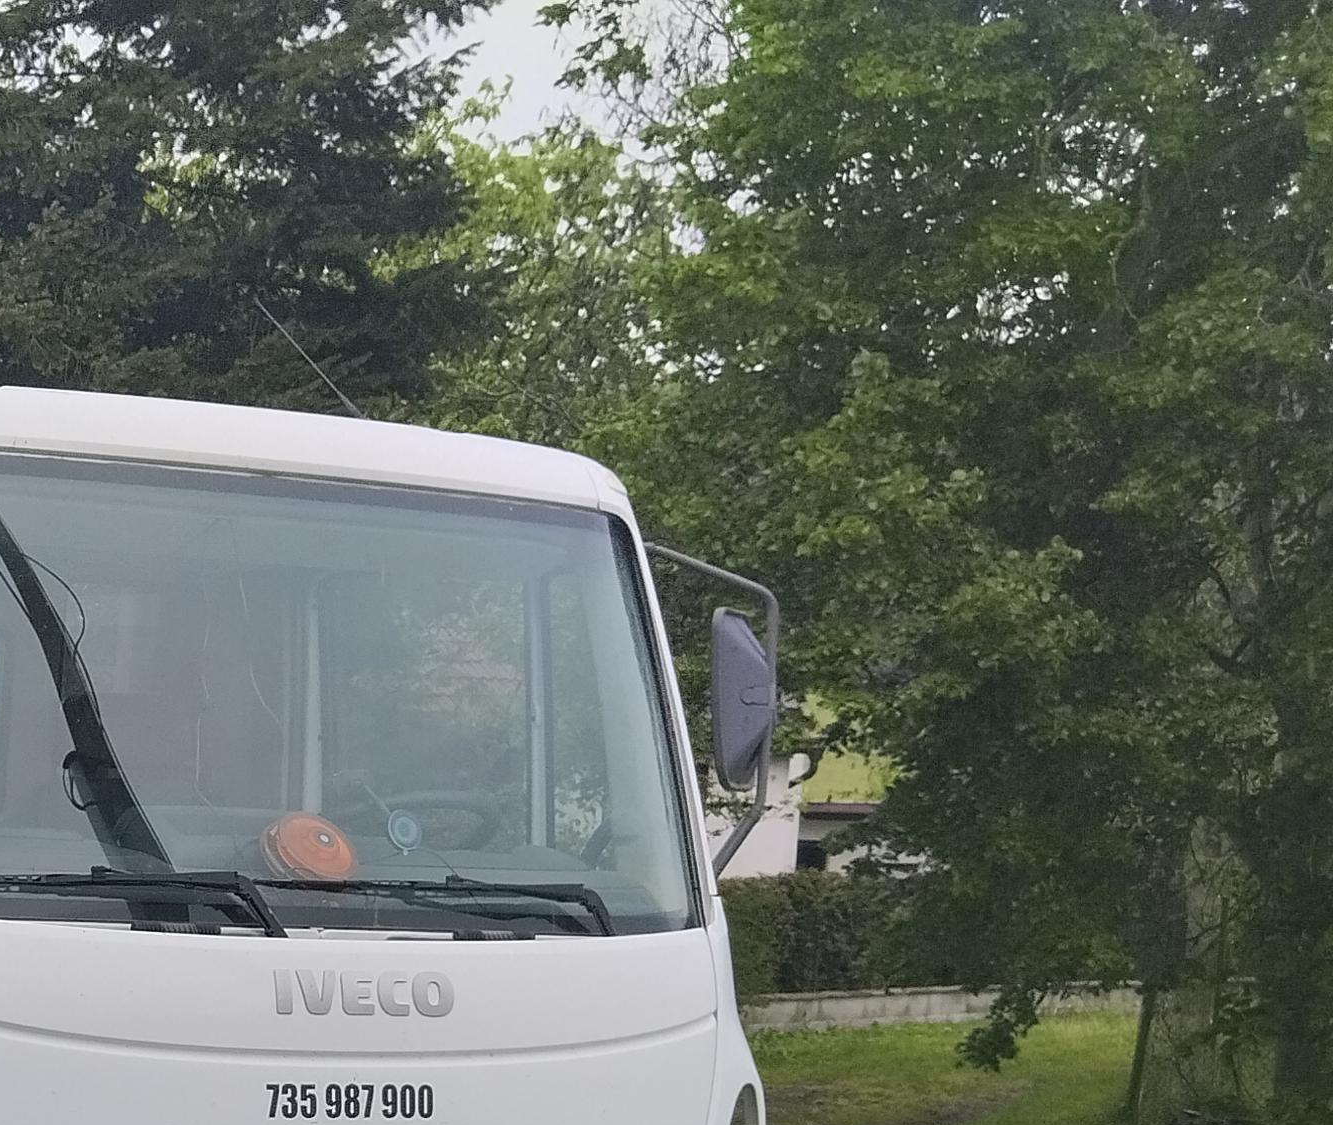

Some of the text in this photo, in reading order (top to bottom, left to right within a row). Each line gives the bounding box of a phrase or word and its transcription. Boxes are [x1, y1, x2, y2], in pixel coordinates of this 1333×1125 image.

[273, 970, 454, 1018] IVECO
[266, 1083, 433, 1118] 735 987 900
